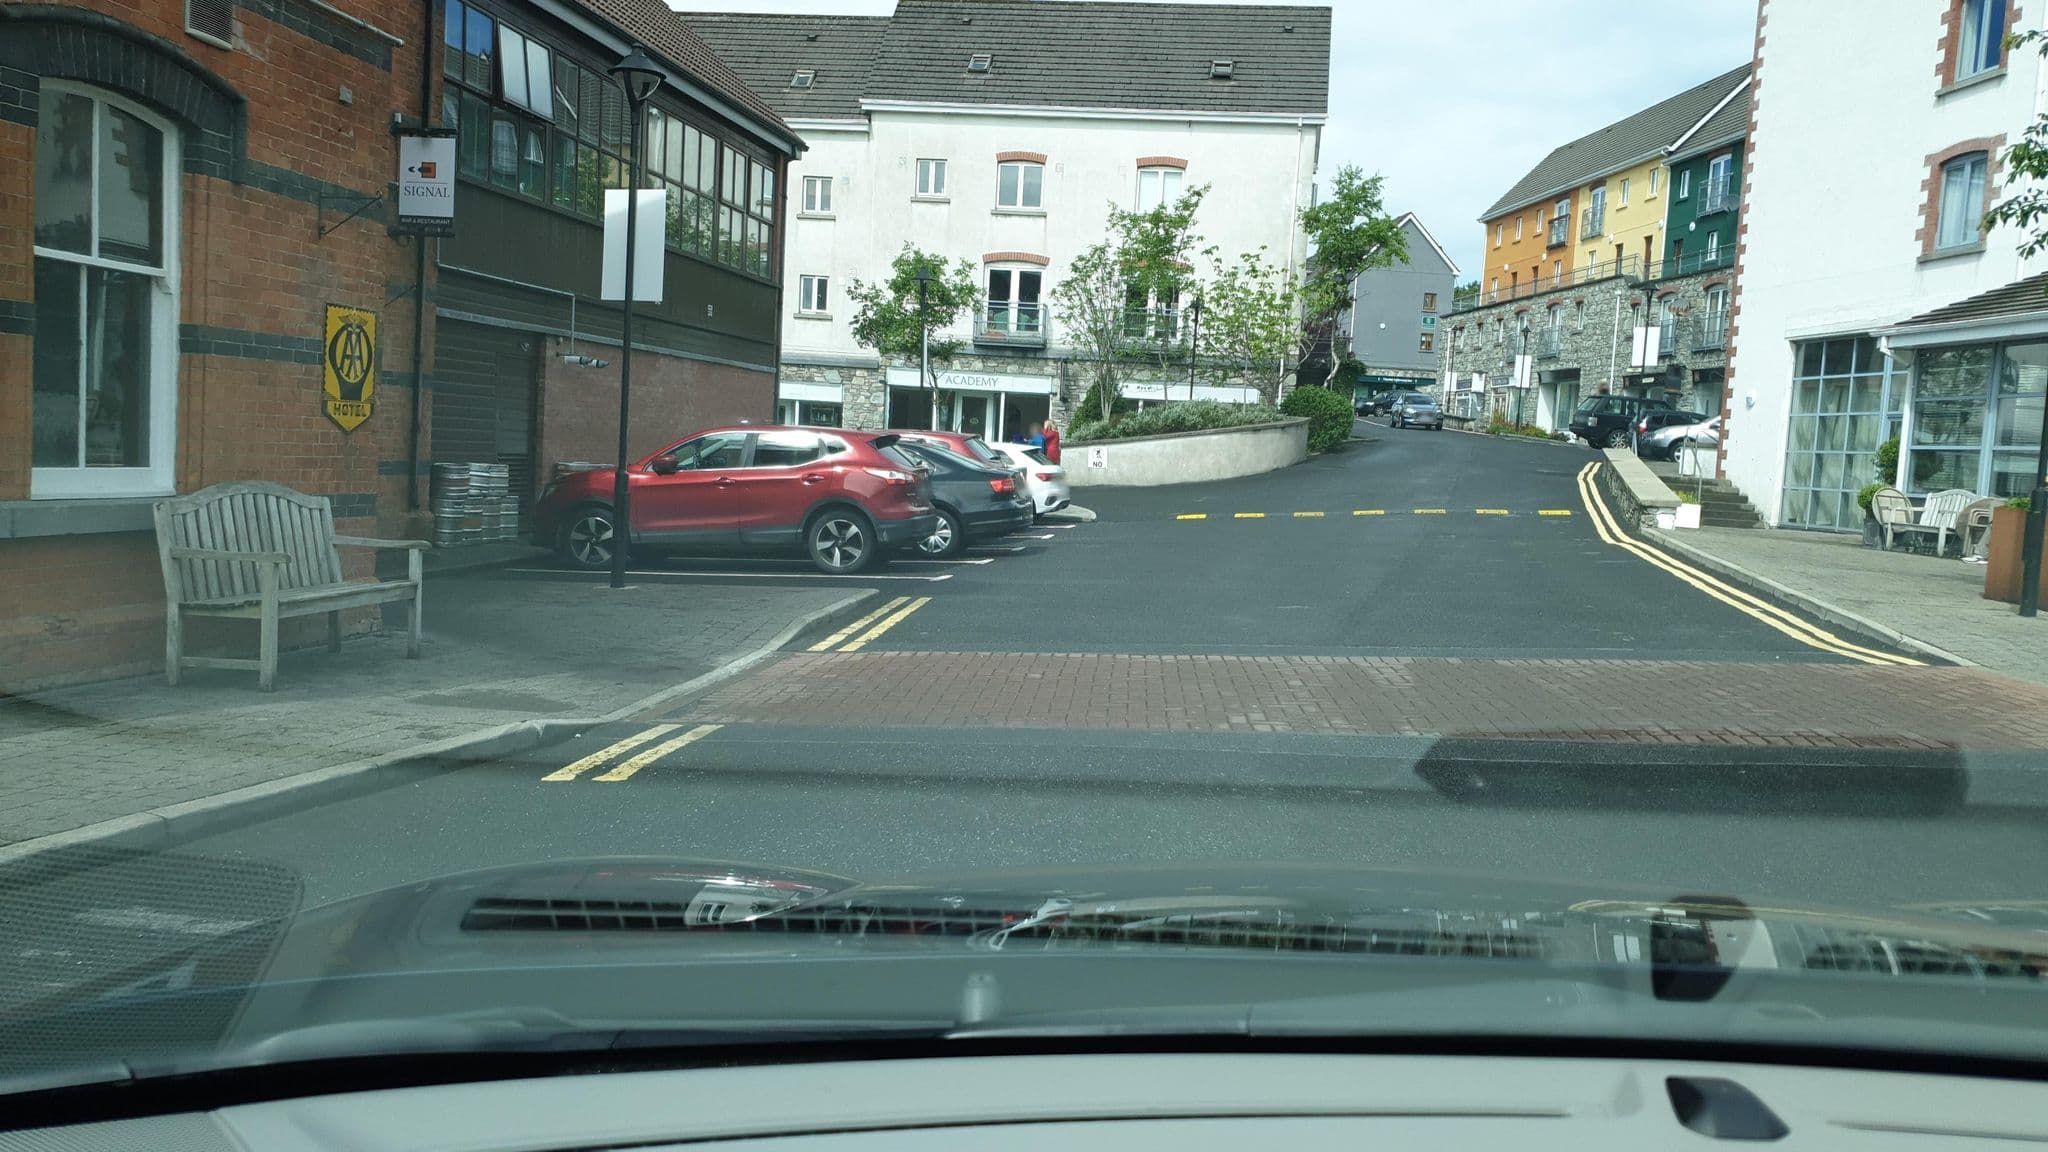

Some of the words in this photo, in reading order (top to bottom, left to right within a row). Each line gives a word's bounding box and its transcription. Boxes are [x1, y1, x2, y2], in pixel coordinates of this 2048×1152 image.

[404, 185, 450, 198] SIGNAL
[945, 375, 999, 388] ACADEMY
[333, 403, 367, 417] HOTEL
